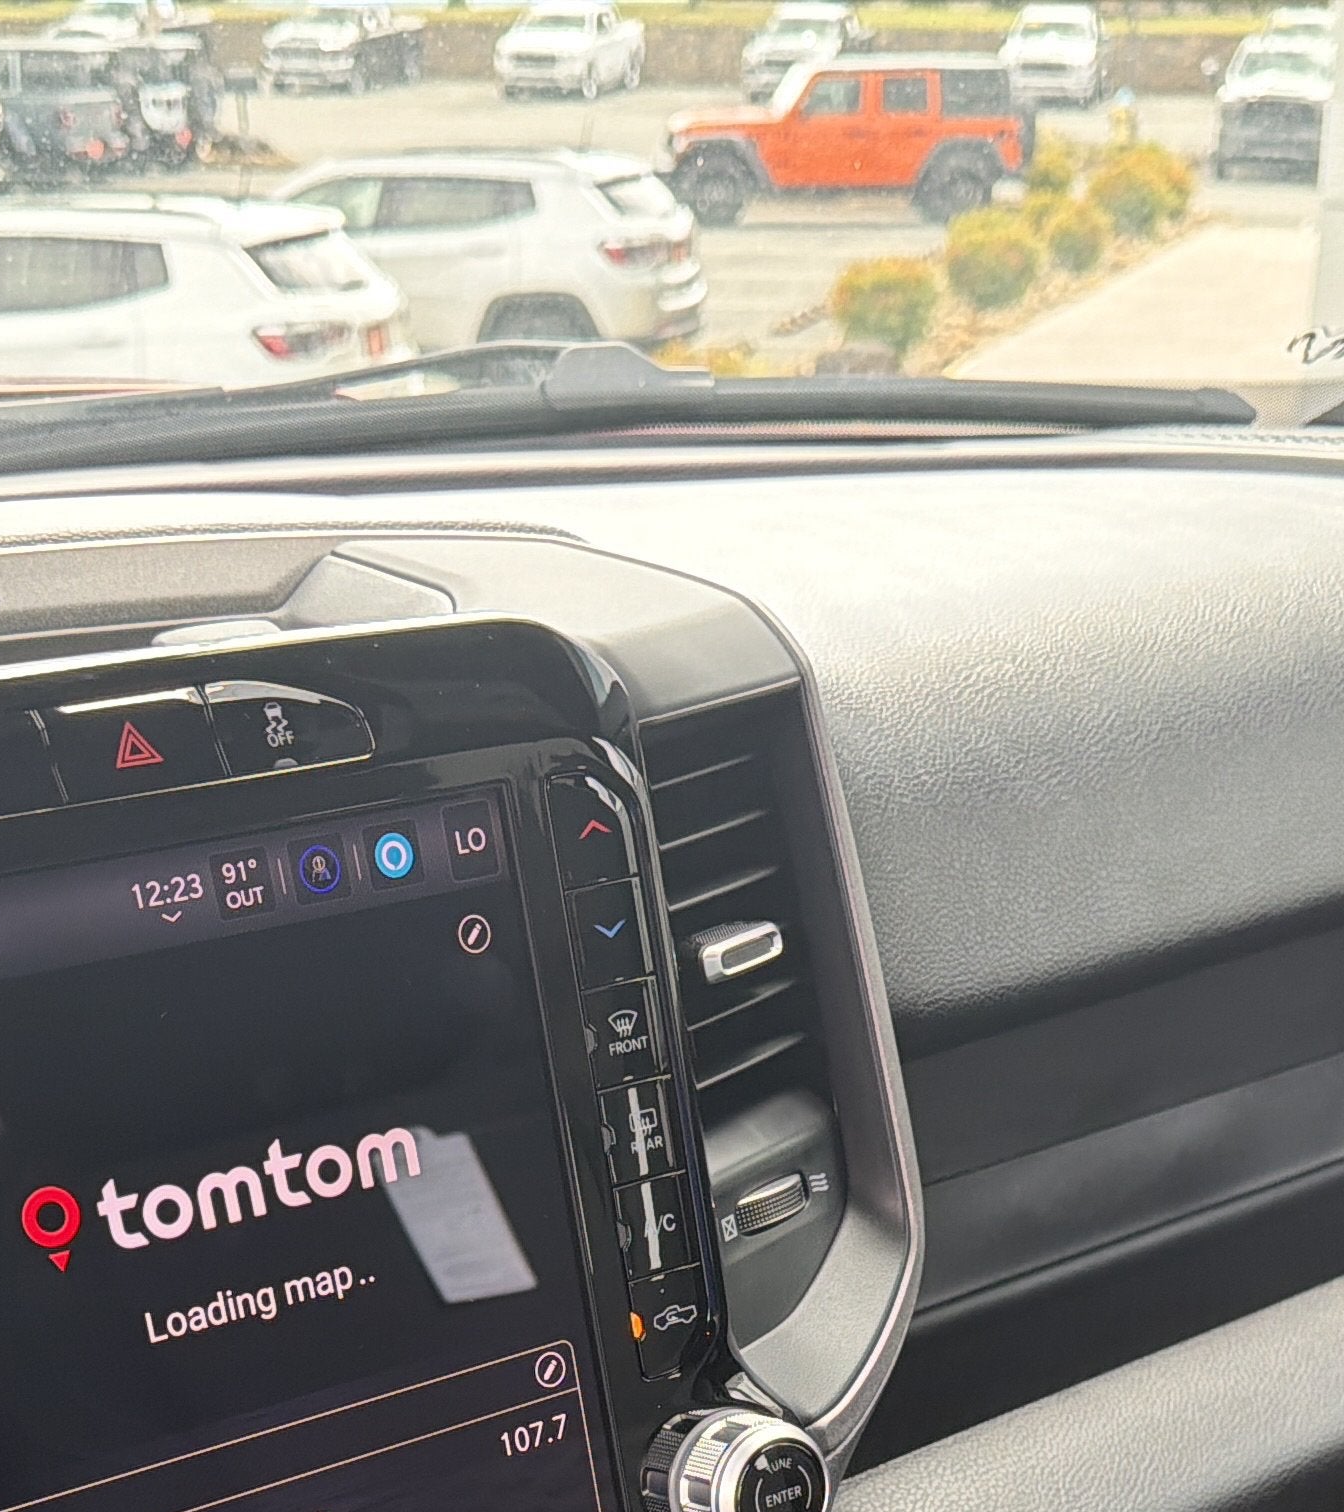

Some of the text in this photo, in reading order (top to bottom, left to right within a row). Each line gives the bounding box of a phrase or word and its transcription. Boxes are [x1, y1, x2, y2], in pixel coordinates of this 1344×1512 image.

[266, 730, 294, 748] OFF
[455, 827, 486, 855] LO
[221, 859, 257, 885] 91°
[131, 874, 204, 910] 12:23
[226, 886, 264, 910] OUT
[609, 1036, 648, 1056] FRONT
[631, 1135, 663, 1154] RAR
[97, 1126, 421, 1250] tomtom
[144, 1283, 278, 1344] Loading
[500, 1413, 567, 1456] 107.7
[766, 1458, 792, 1474] TUNE
[766, 1485, 802, 1508] ENTER
